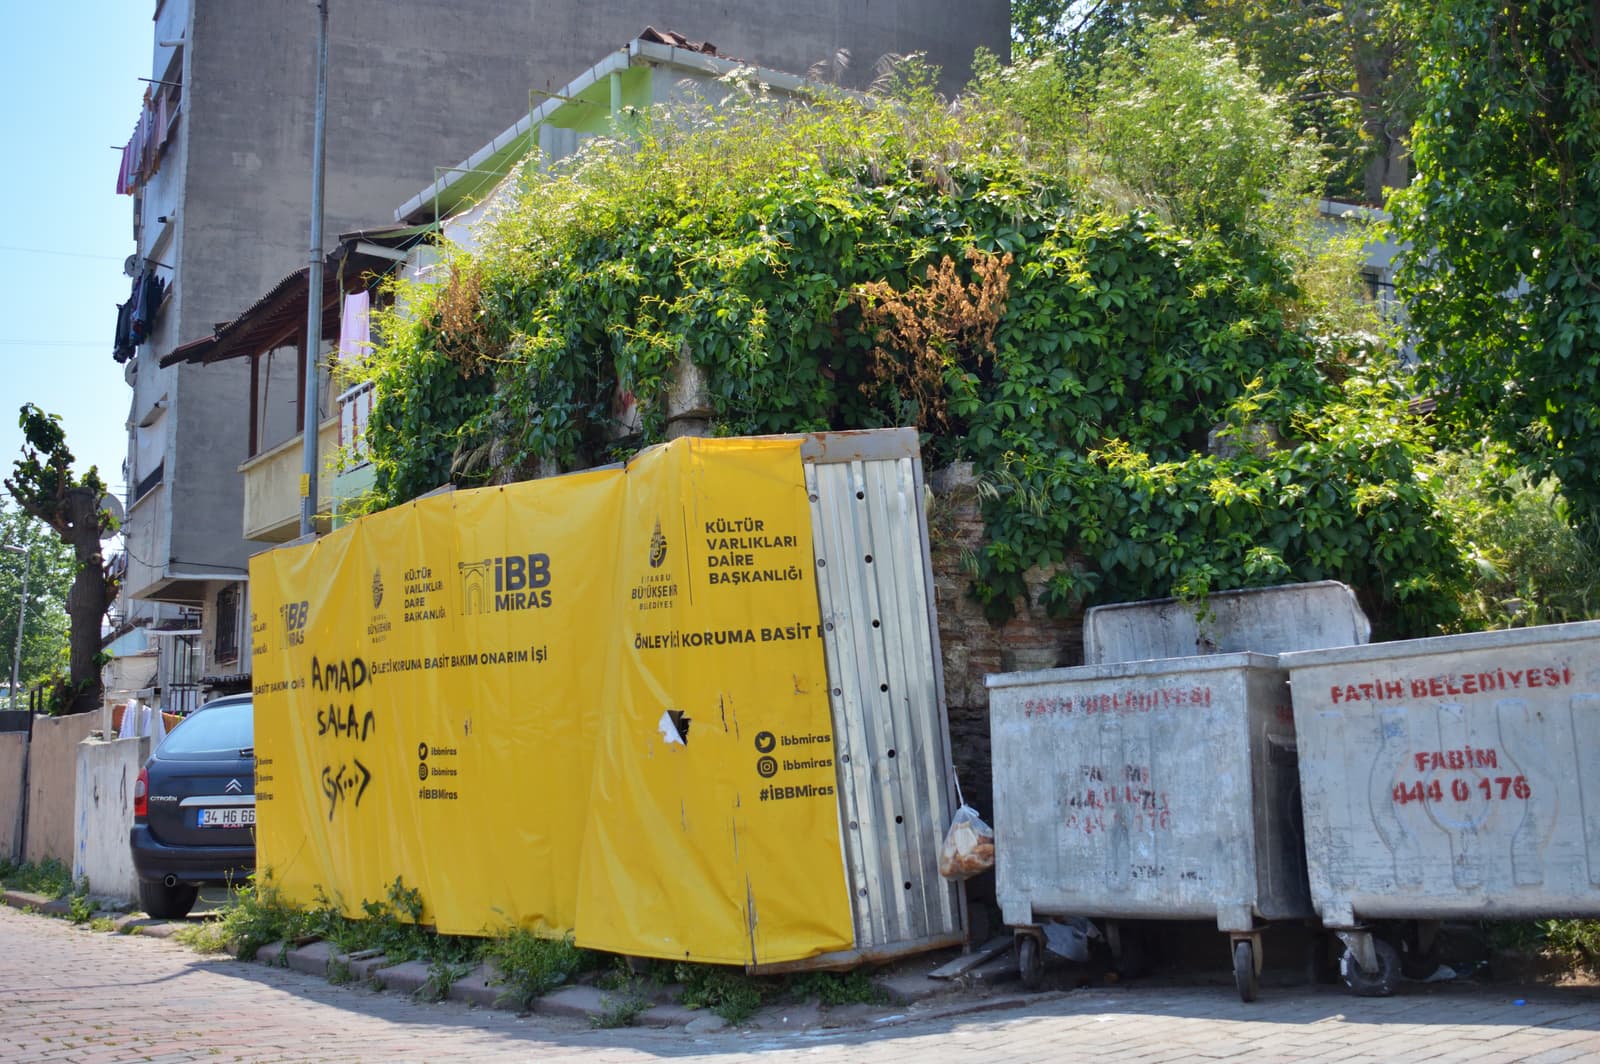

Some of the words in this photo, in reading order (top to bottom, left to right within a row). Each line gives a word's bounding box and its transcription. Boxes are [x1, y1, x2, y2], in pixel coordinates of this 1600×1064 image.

[705, 517, 764, 534] KÜLTÜR
[706, 535, 797, 550] VARLIKLARI
[708, 551, 754, 567] DAİRE
[404, 567, 432, 582] KÜTÜR
[709, 566, 802, 586] BAŞKANLIĞI
[682, 629, 756, 648] KORUMA
[761, 622, 812, 642] BASİT
[424, 653, 450, 669] BASİT
[480, 650, 528, 665] ONARIM
[531, 645, 547, 664] İŞİ
[1330, 678, 1403, 704] FATİH
[1410, 666, 1575, 699] BELEDİYESİ
[781, 733, 831, 746] ibbmiras
[783, 757, 833, 771] ibbmiras
[1414, 745, 1498, 772] FABİM
[760, 784, 834, 801] #İBBMiras
[1393, 779, 1443, 805] 444
[1451, 778, 1469, 802] 0
[1479, 775, 1531, 800] 176
[204, 810, 217, 823] 34
[223, 810, 238, 823] HG
